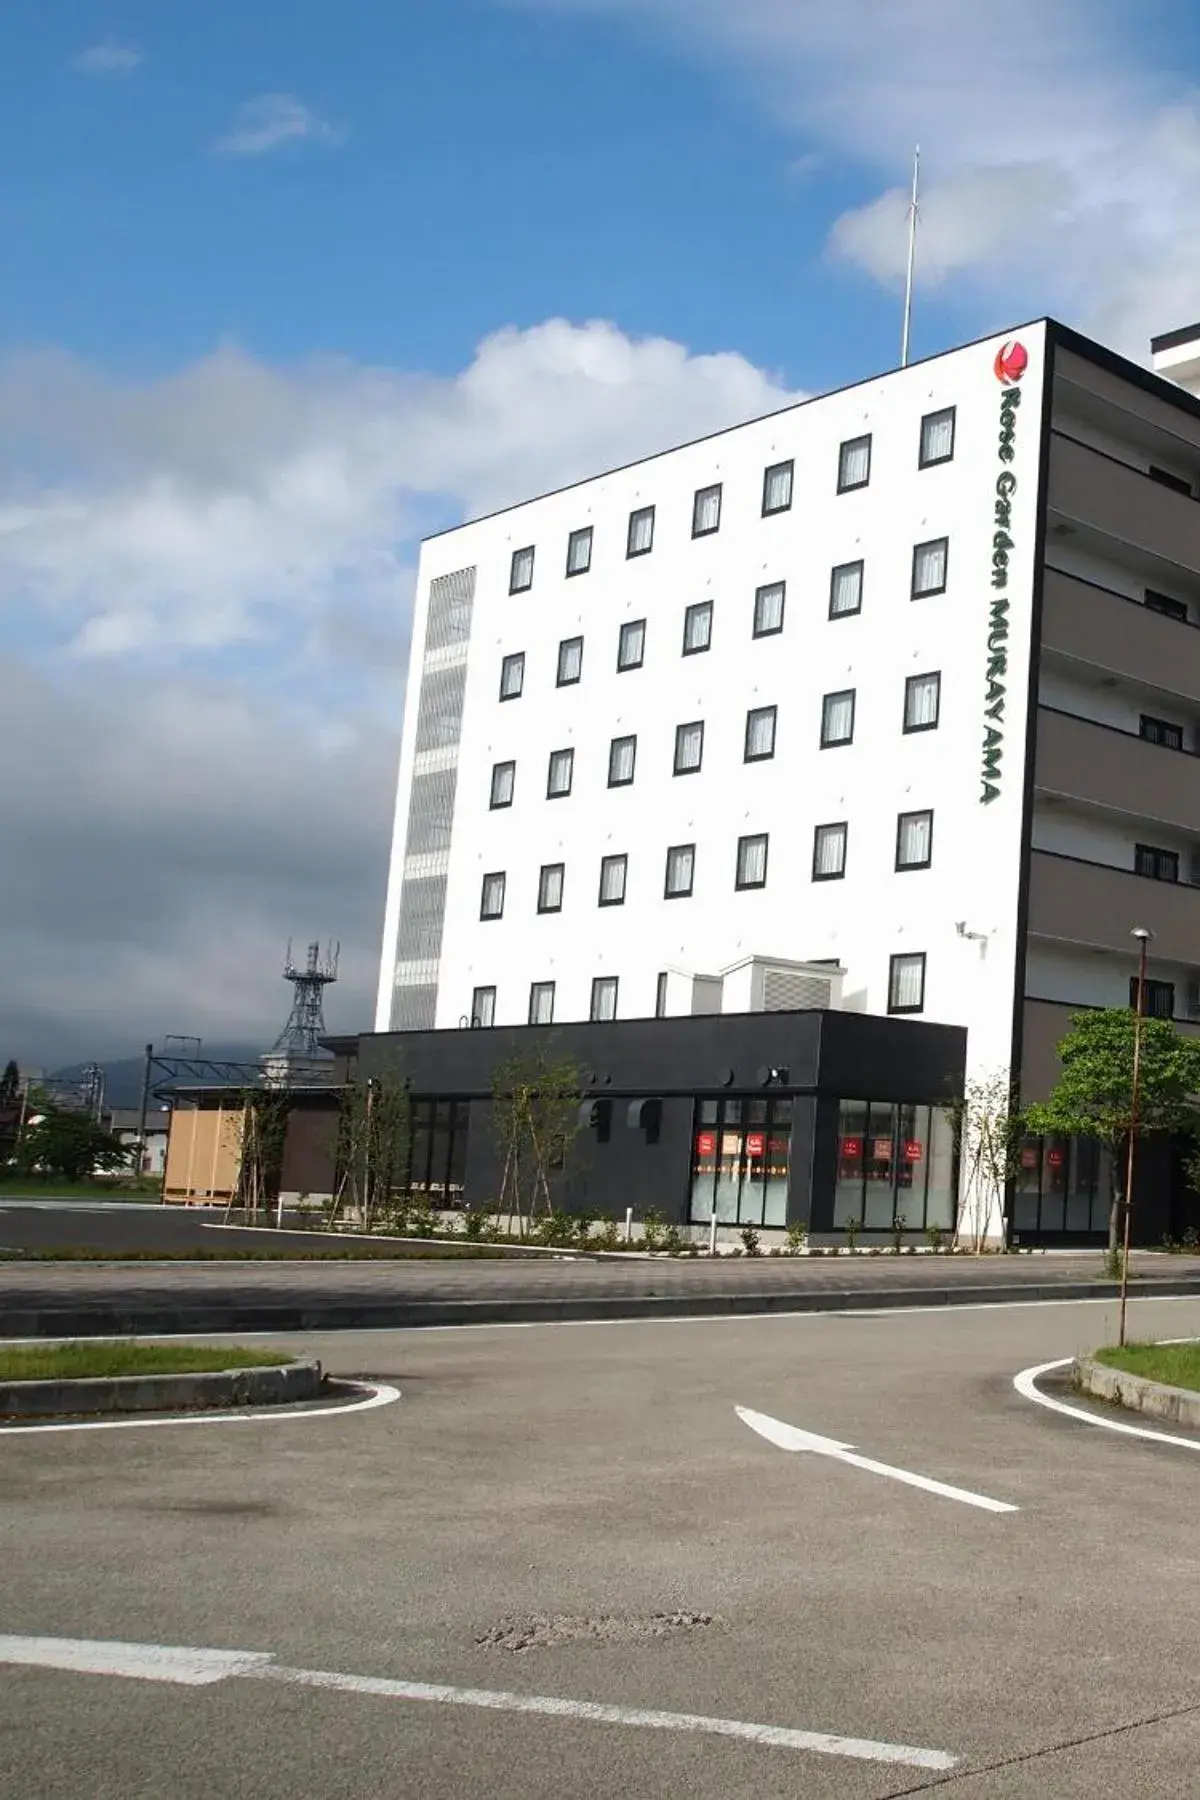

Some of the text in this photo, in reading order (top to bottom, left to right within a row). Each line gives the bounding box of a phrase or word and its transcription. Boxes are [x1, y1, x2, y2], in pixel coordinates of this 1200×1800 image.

[979, 387, 1021, 806] Rose Garden MURAYAMA
